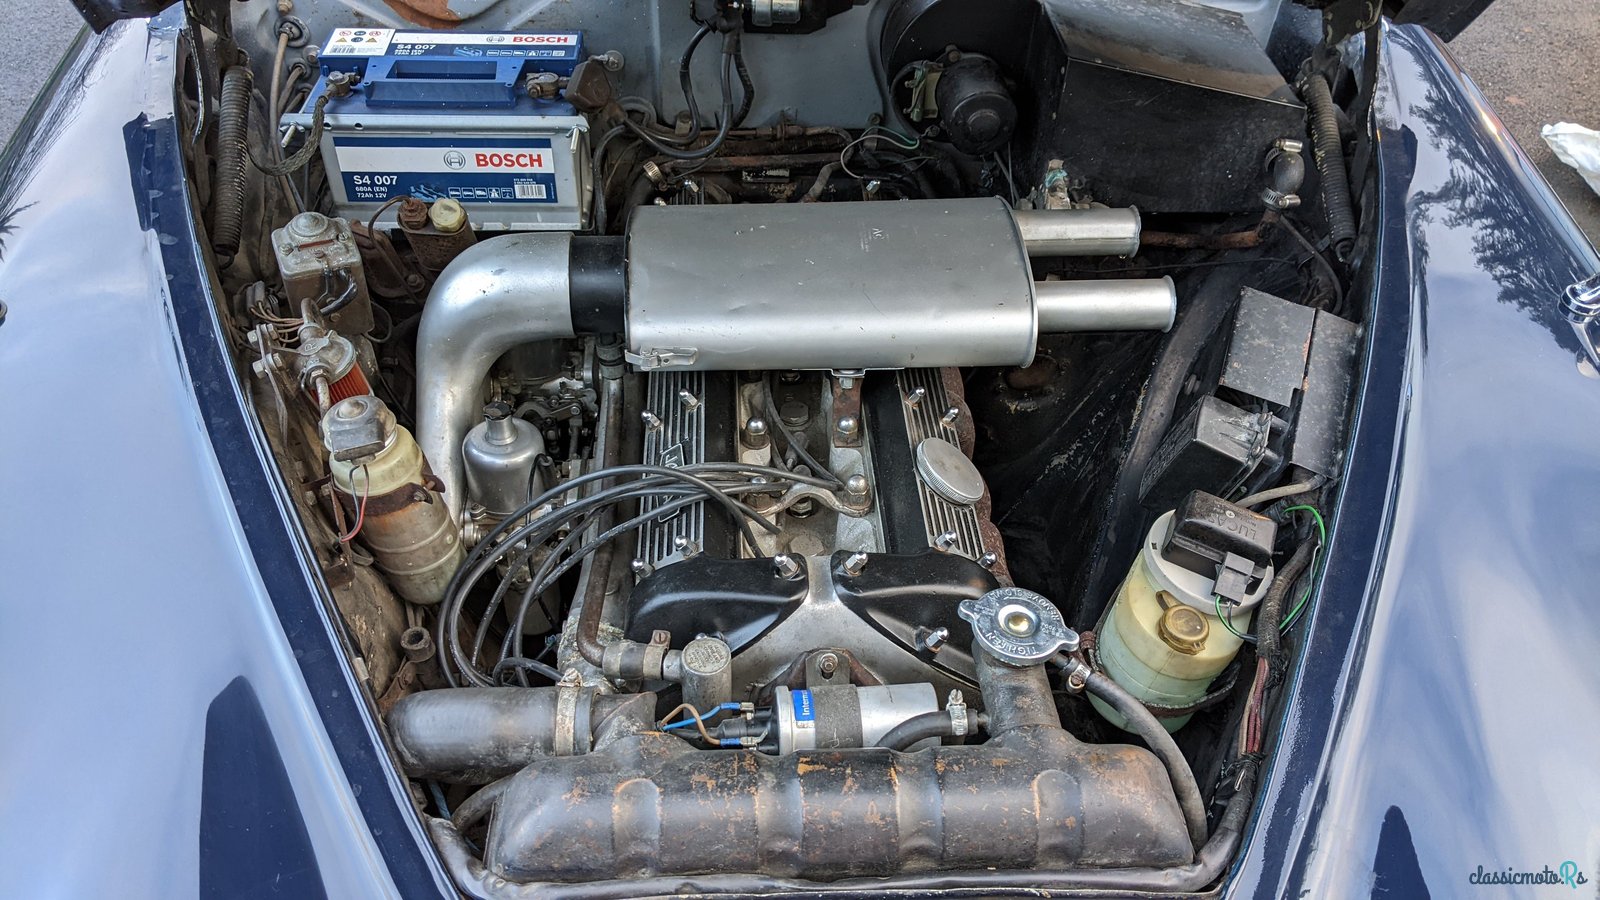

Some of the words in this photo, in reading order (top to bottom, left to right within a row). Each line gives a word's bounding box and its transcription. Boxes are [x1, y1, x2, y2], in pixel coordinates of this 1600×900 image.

[475, 153, 543, 168] BOSCH
[353, 175, 371, 185] S4
[374, 175, 398, 185] 007
[1207, 512, 1257, 541] LUCAS
